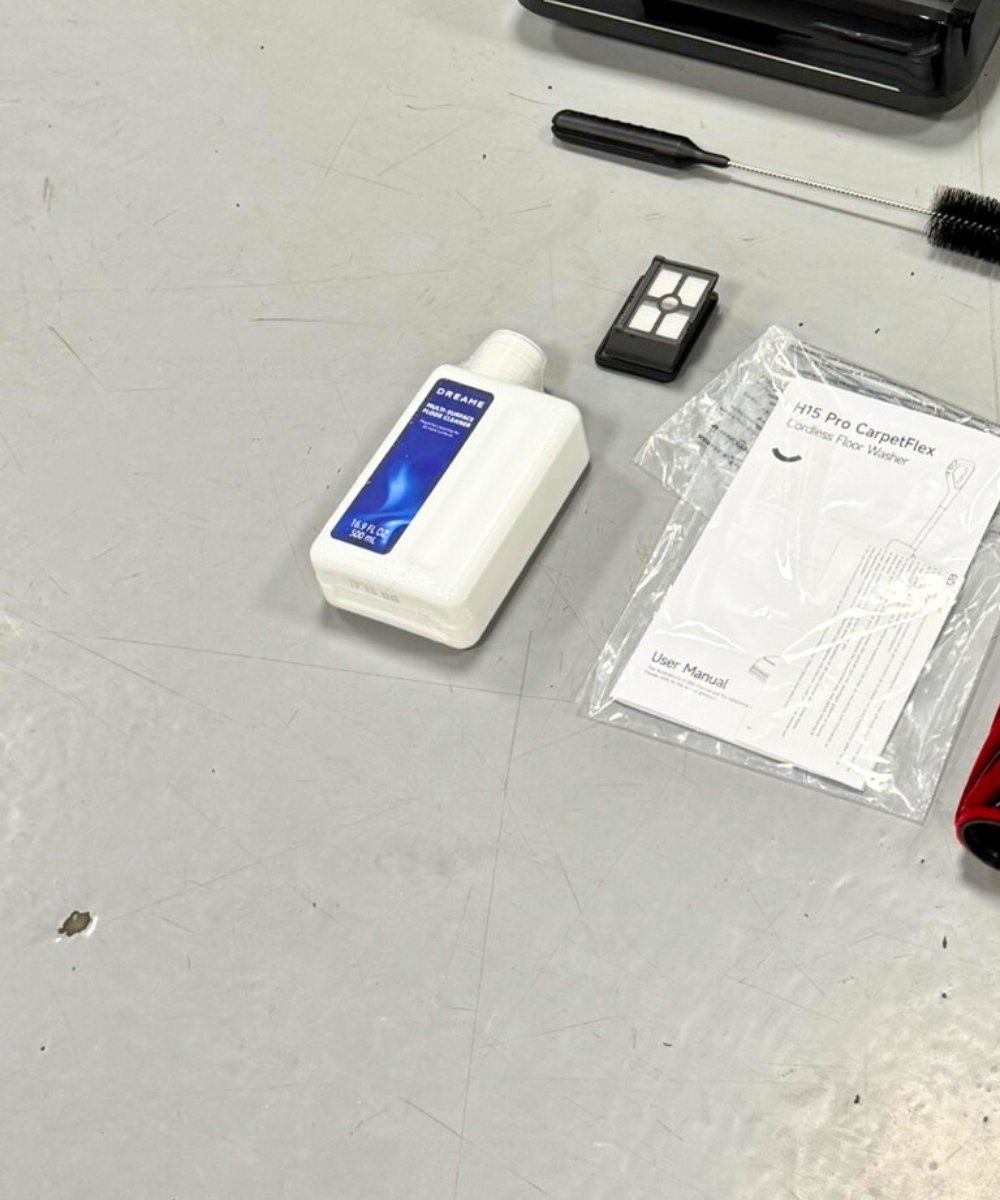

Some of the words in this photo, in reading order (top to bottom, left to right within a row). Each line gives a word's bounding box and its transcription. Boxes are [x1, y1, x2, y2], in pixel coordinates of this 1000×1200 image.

[436, 387, 485, 409] DREAME
[422, 408, 444, 419] FLOOR
[442, 415, 472, 429] CLEANER
[793, 402, 823, 419] H15
[825, 411, 851, 430] Pro
[856, 422, 937, 457] CarpetFlex
[786, 418, 834, 442] Cordless
[835, 434, 866, 451] Floor
[867, 444, 910, 466] Washer
[349, 528, 365, 539] 500
[350, 518, 367, 530] 16.9
[366, 524, 376, 534] FL
[651, 651, 681, 669] User
[682, 663, 730, 689] Manual
